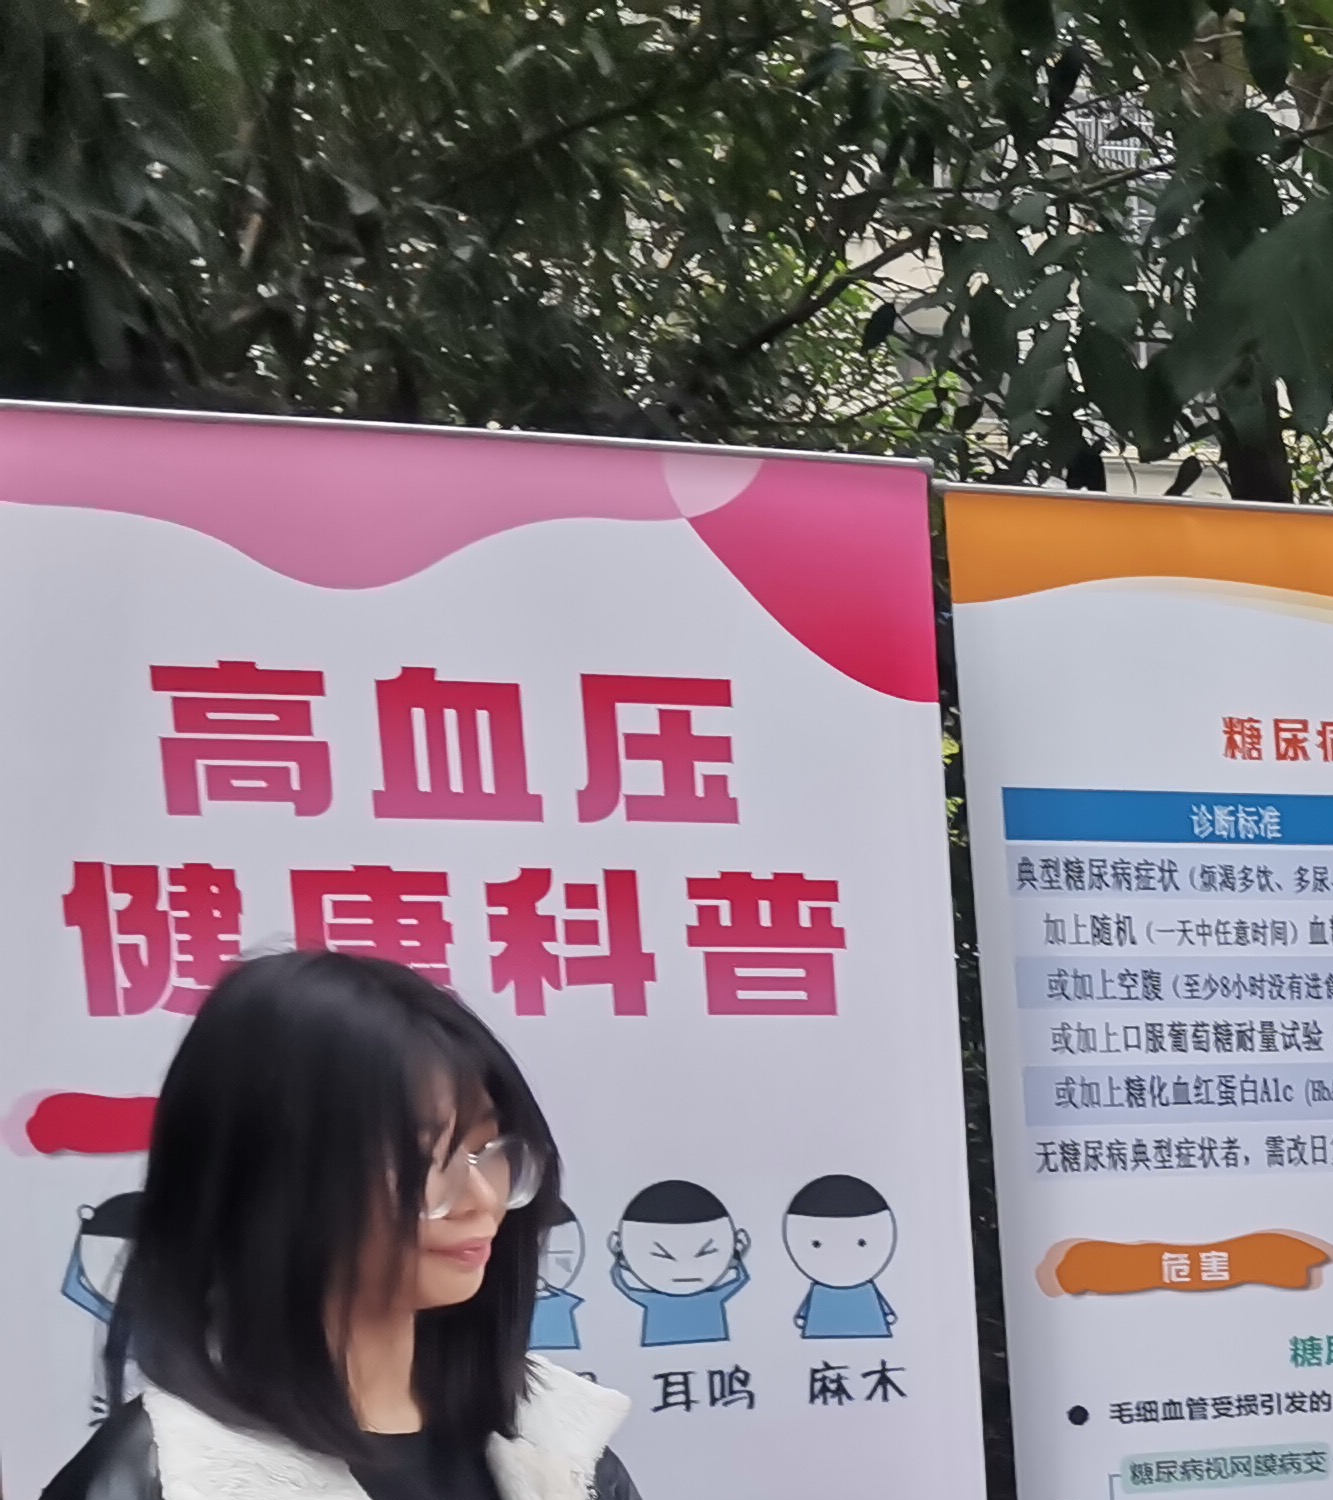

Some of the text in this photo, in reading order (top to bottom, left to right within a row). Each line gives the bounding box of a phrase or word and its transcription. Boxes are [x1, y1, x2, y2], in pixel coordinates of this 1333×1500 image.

[149, 660, 740, 825] 高血压
[1190, 804, 1283, 840] 诊断标准
[61, 861, 848, 1018] 健康科普
[1160, 1250, 1231, 1284] 危害
[652, 1364, 755, 1413] 耳鸣
[809, 1359, 907, 1406] 麻木
[1109, 1390, 1333, 1424] 毛细血管受损引发的
[1129, 1450, 1328, 1486] 糖尿病视网膜病变
